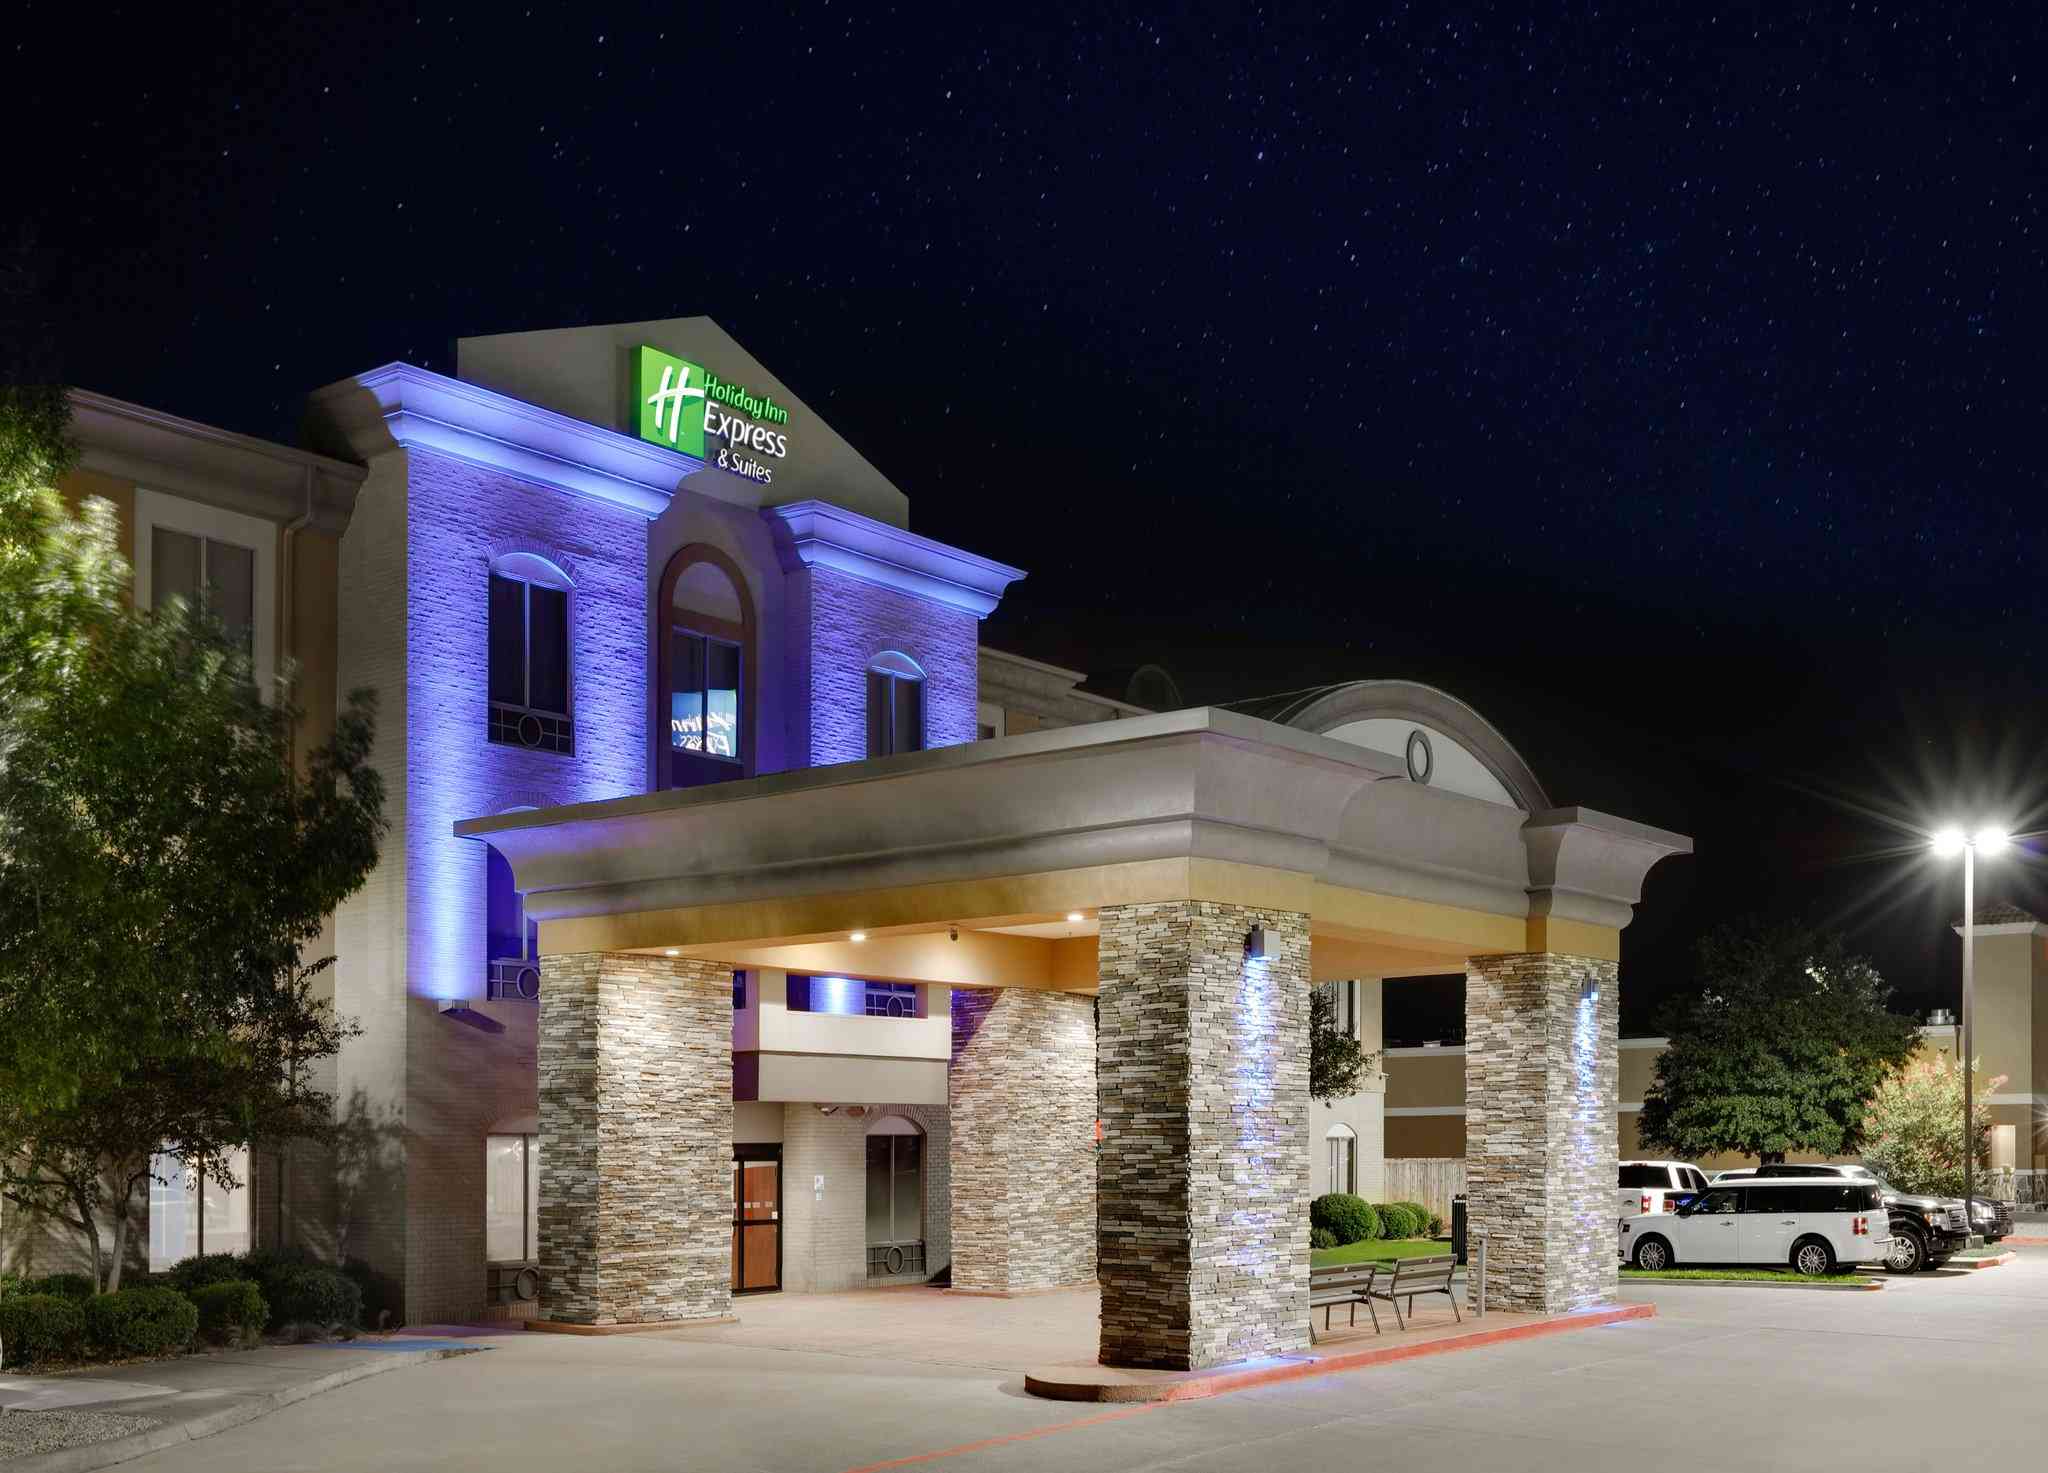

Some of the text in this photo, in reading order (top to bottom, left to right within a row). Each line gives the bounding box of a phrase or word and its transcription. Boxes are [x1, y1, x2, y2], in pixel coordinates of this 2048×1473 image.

[704, 374, 788, 424] Holiday Inn
[704, 401, 788, 459] Express
[717, 448, 772, 483] & Suites
